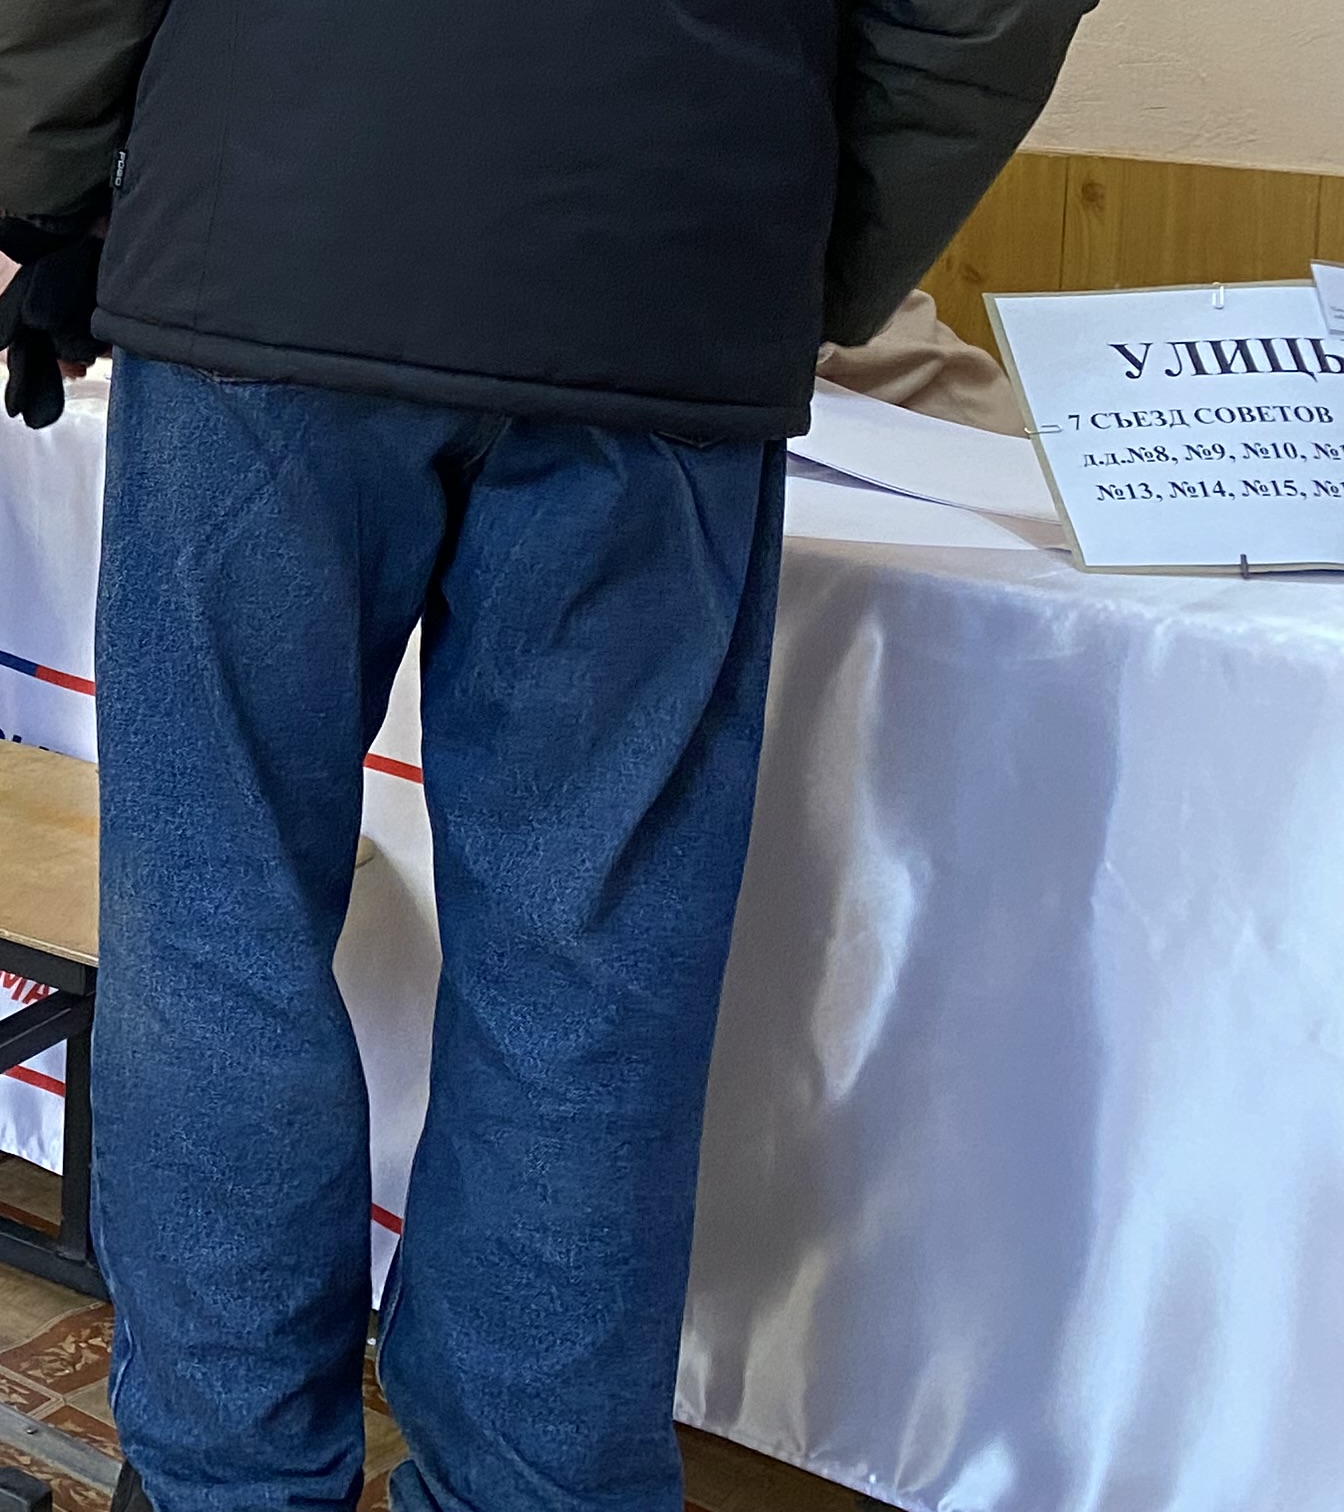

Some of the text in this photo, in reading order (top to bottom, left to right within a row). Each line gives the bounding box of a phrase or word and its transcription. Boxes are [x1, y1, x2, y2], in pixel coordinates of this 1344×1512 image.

[1068, 405, 1334, 431] 7 СЪЕЗД СОВЕТОВ
[1184, 443, 1237, 464] №9,
[1242, 441, 1308, 463] №10,
[1096, 482, 1164, 503] №13,
[1168, 480, 1236, 501] №14,
[1241, 479, 1308, 501] №15,
